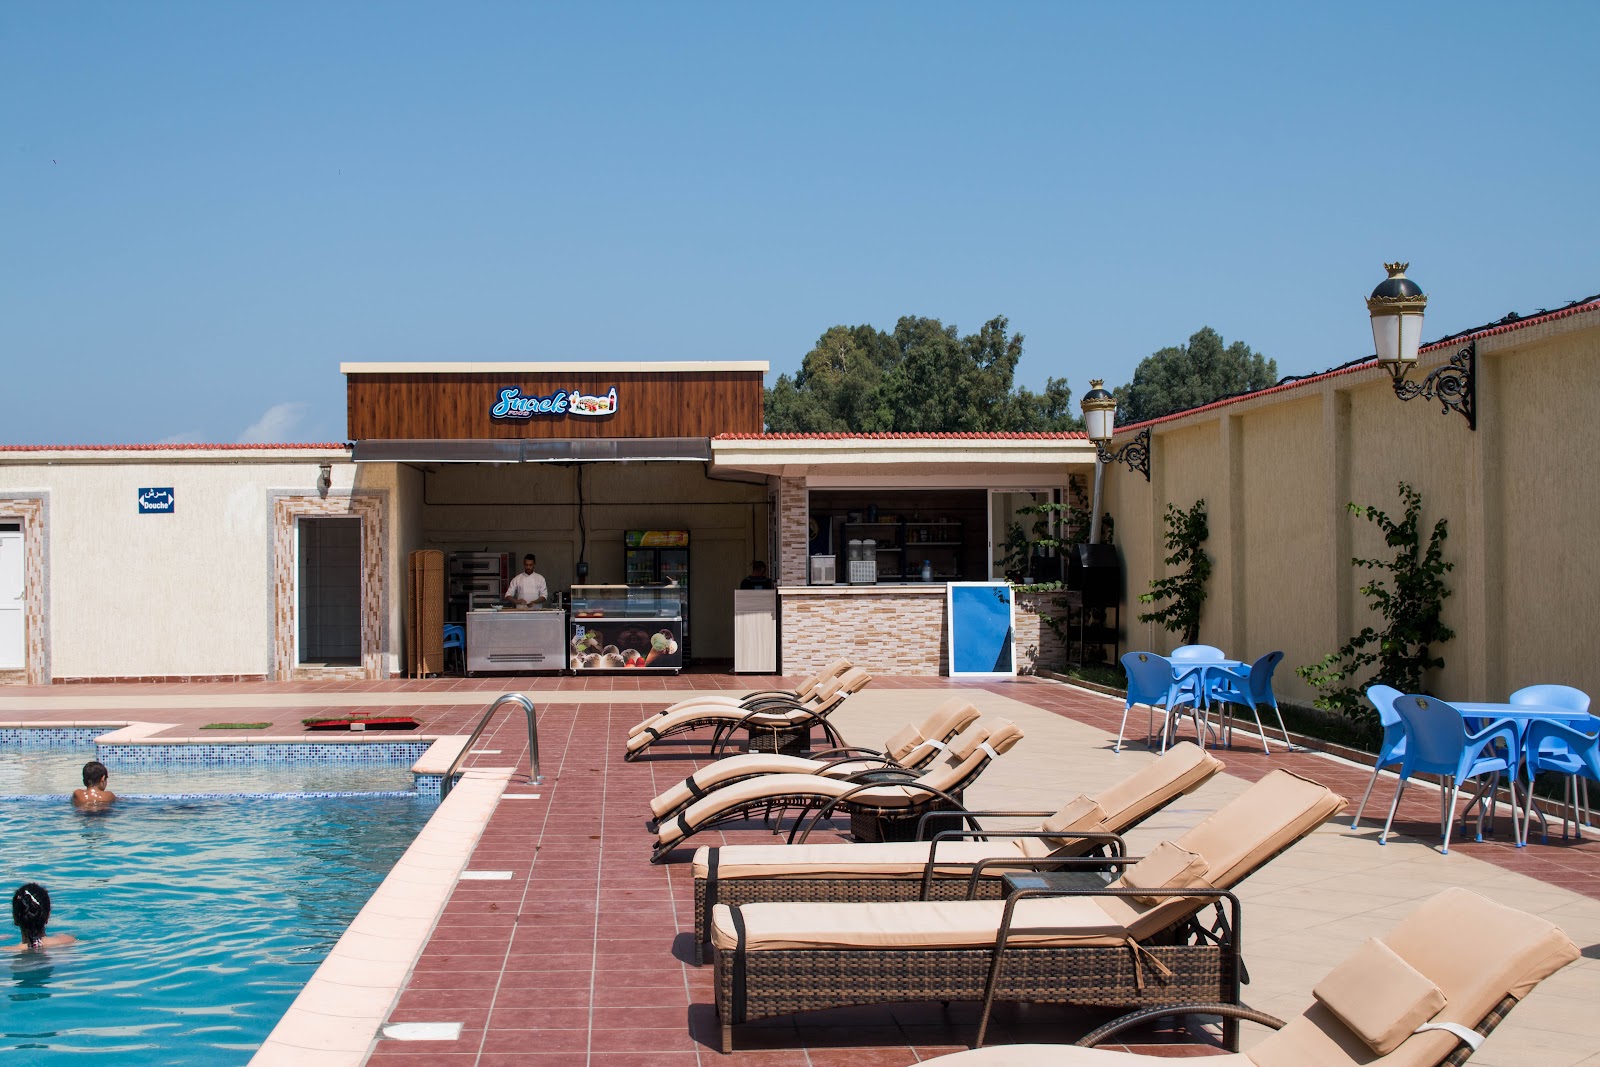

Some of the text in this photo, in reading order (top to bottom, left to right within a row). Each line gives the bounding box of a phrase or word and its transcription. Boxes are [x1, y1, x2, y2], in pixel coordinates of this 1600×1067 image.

[492, 388, 568, 416] Snack
[144, 488, 167, 498] مرش
[144, 501, 169, 509] Douche
